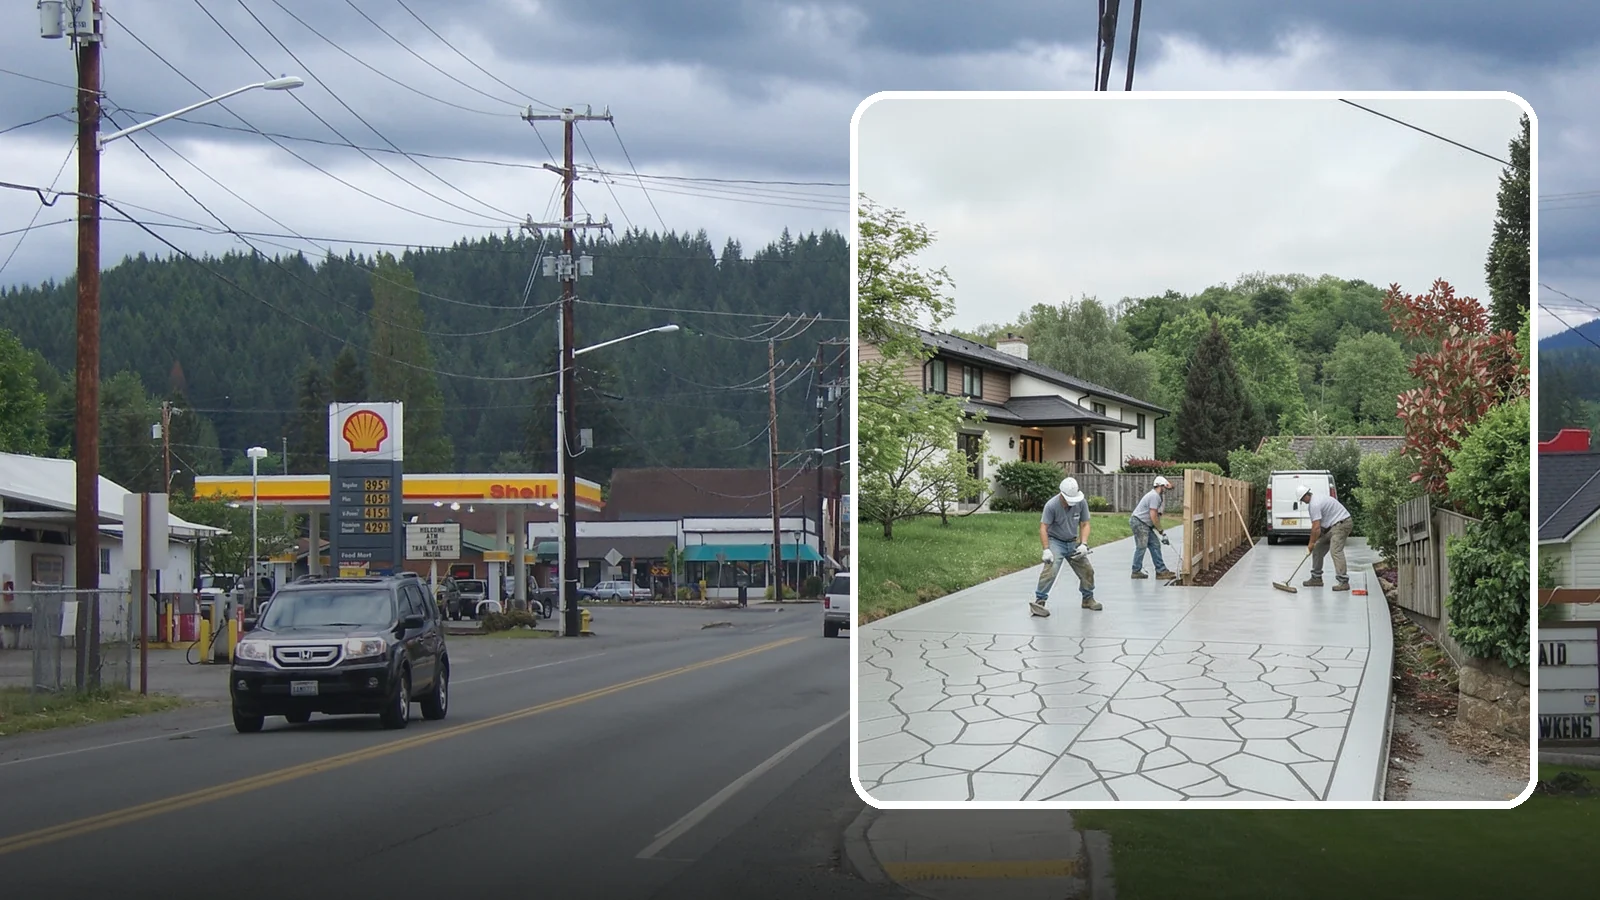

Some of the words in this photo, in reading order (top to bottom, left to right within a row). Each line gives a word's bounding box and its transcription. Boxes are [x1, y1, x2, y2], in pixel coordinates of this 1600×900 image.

[366, 480, 383, 490] 395
[490, 484, 547, 499] Shell
[366, 494, 383, 504] 405
[366, 508, 383, 518] 415
[366, 522, 383, 532] 429
